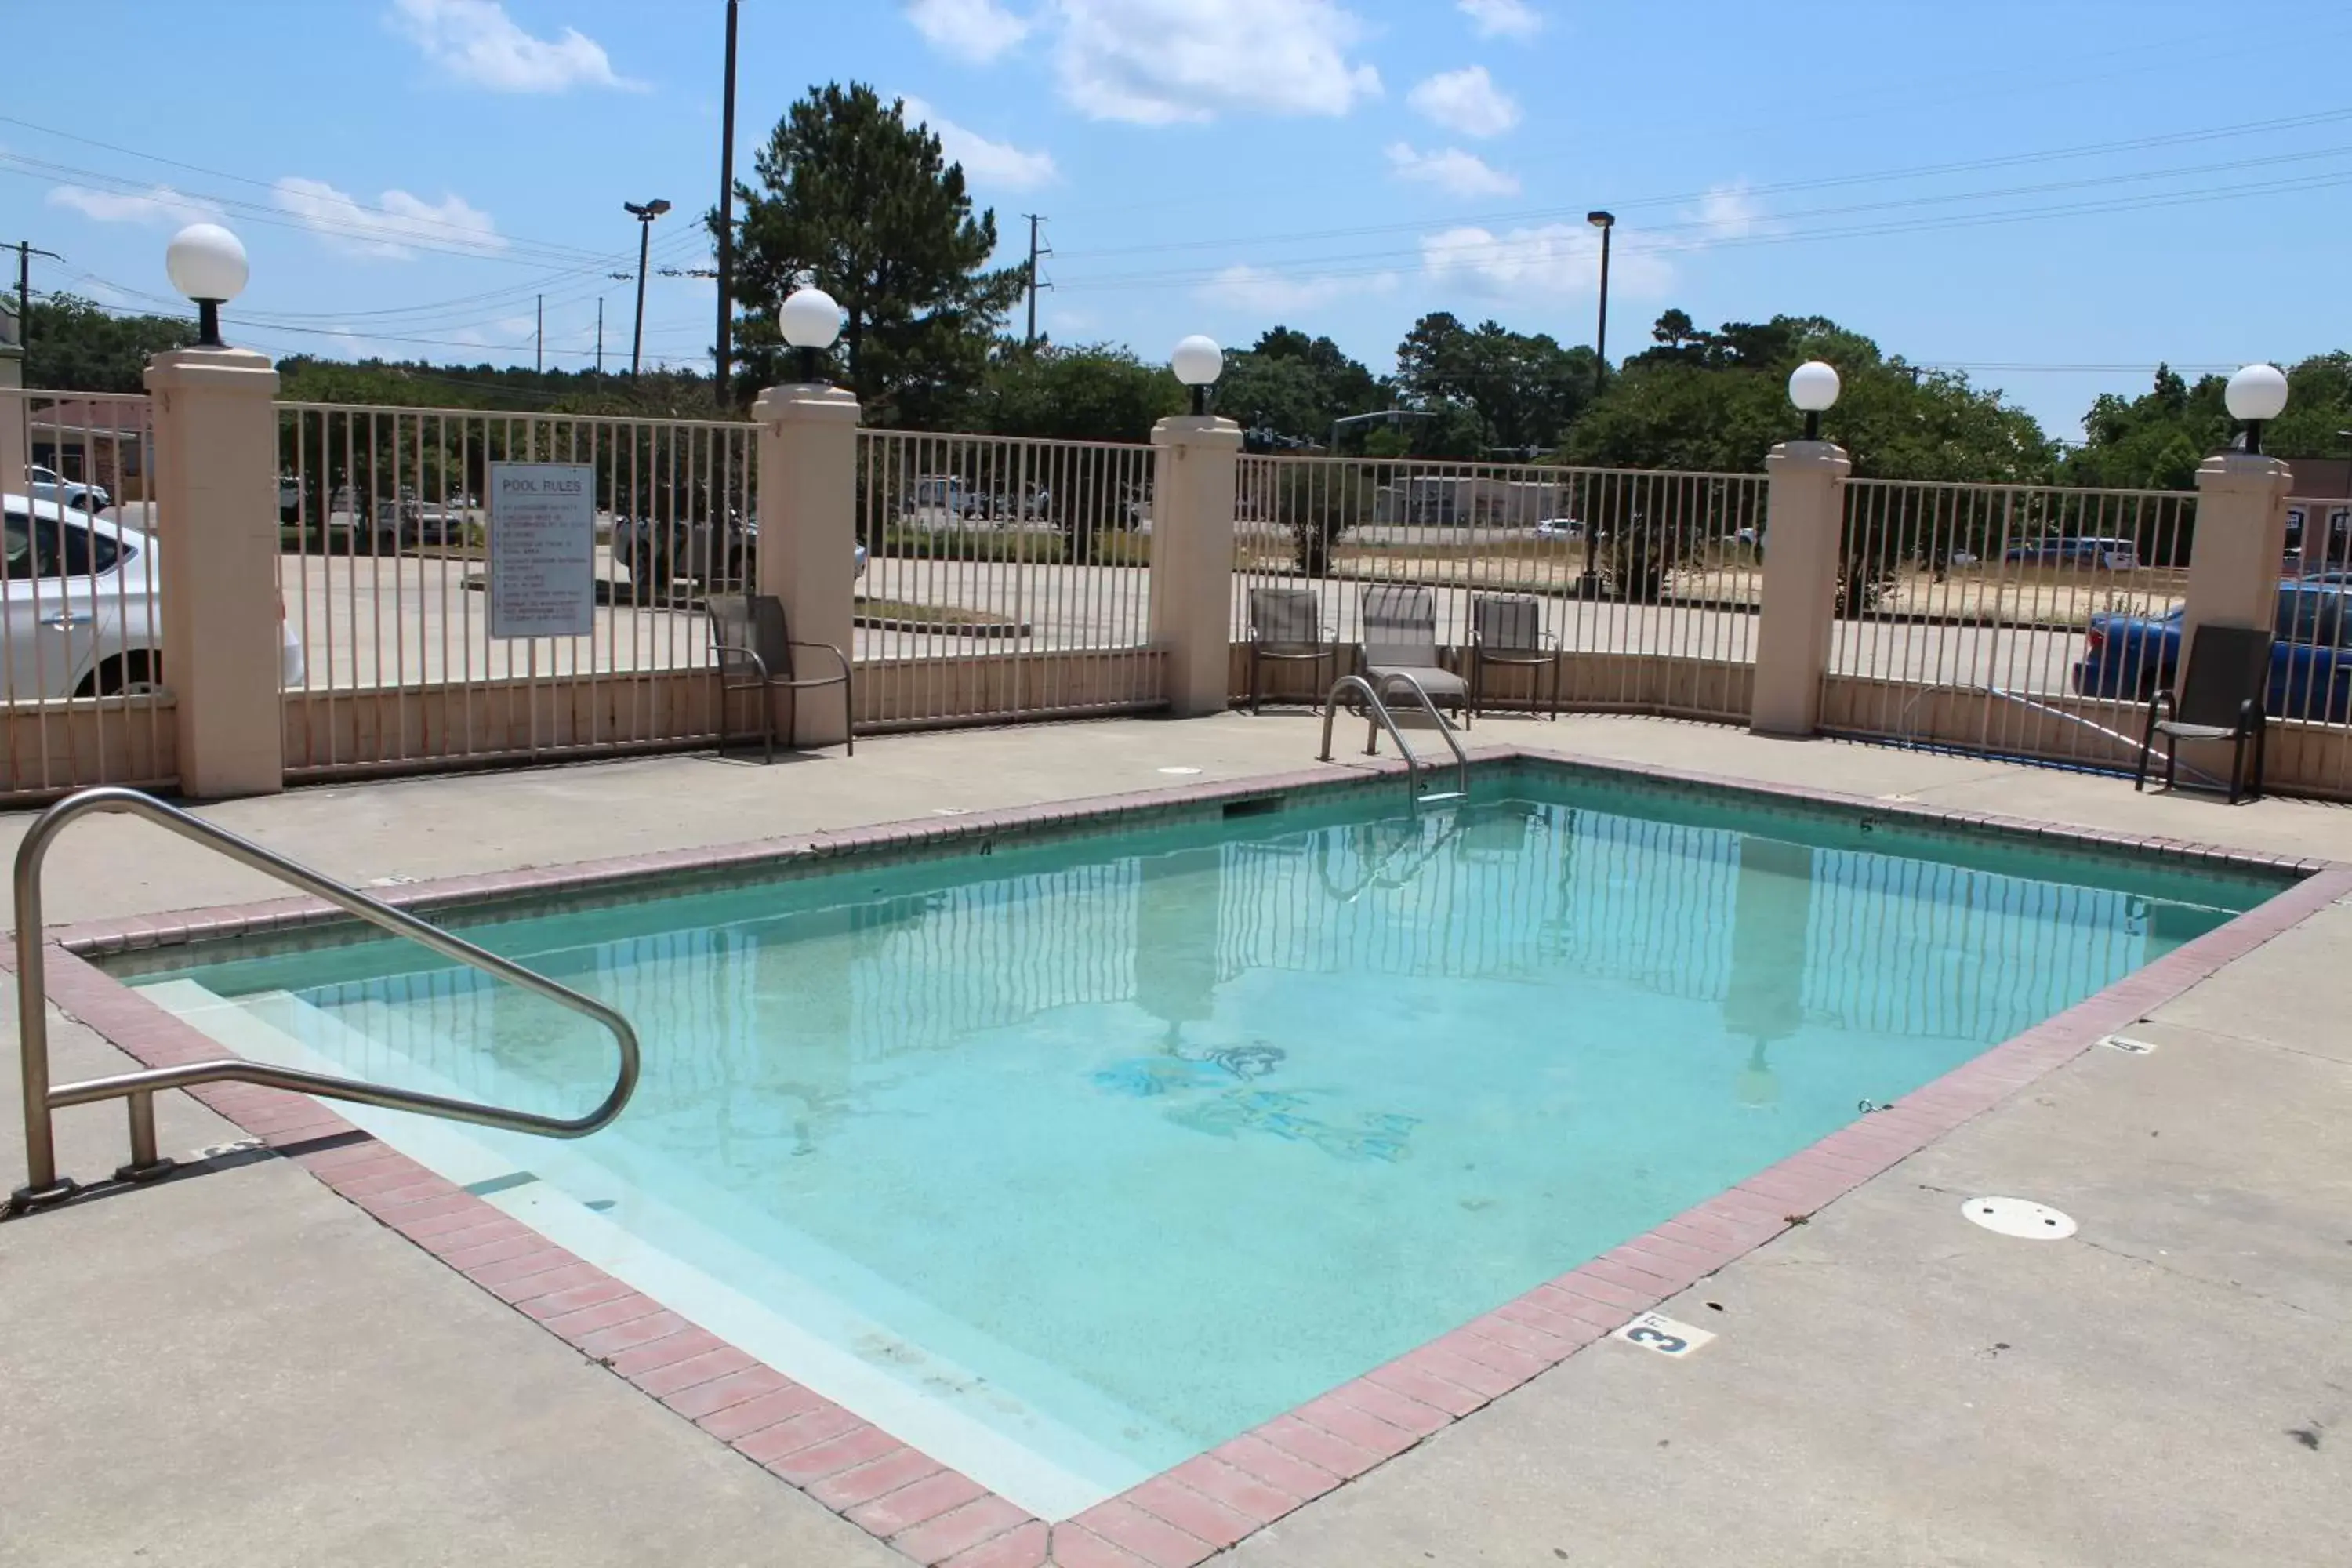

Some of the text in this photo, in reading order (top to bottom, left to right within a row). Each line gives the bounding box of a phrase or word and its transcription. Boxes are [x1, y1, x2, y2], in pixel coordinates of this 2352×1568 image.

[503, 479, 582, 492] POOL RULES
[1627, 1327, 1687, 1352] 3
